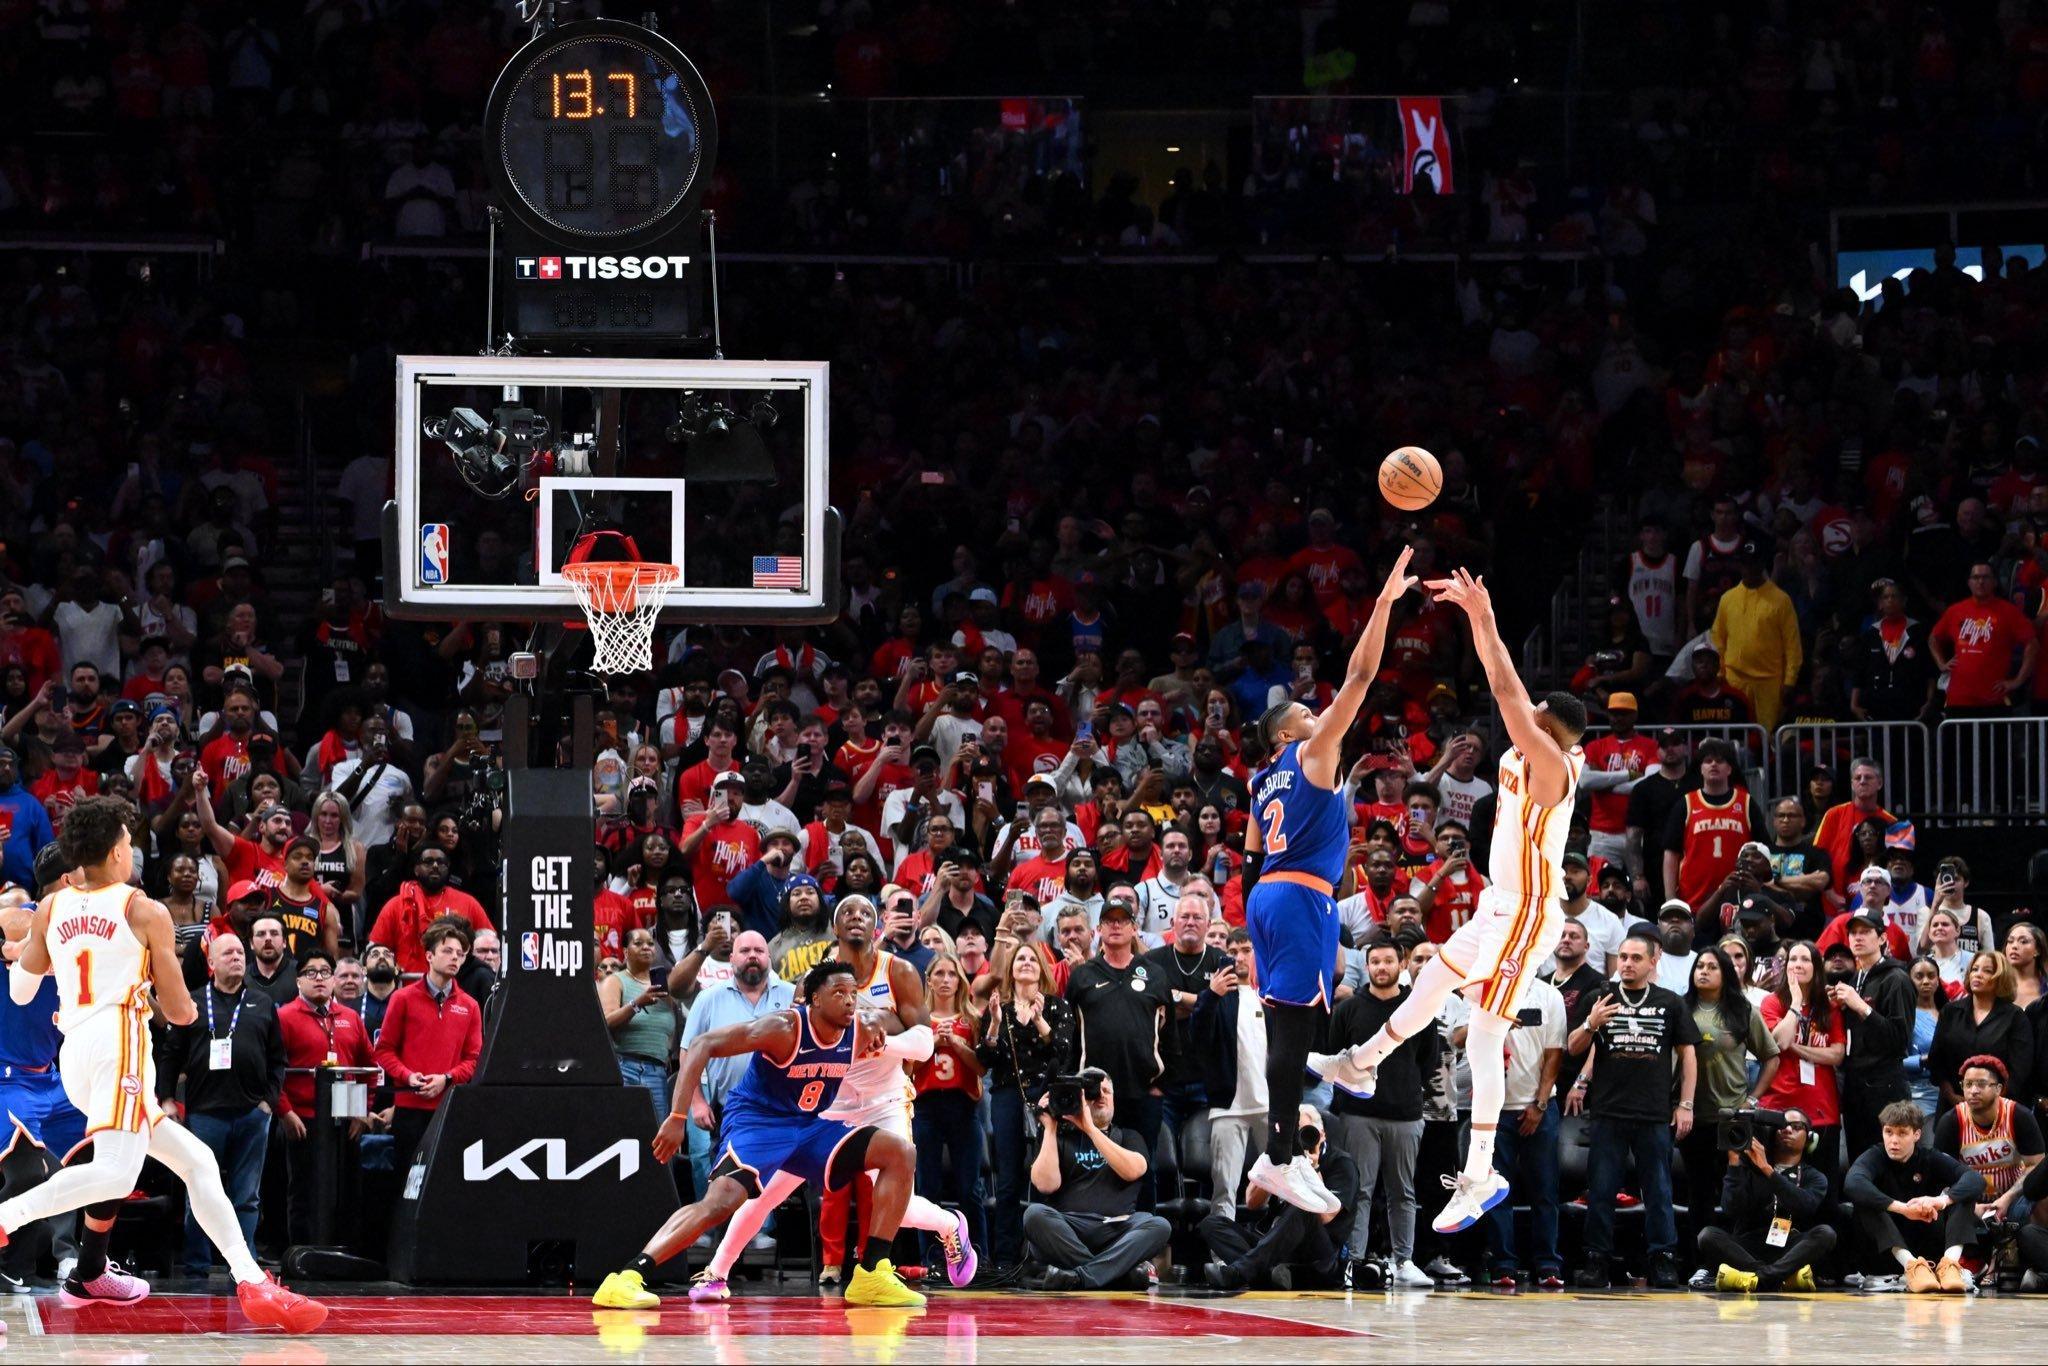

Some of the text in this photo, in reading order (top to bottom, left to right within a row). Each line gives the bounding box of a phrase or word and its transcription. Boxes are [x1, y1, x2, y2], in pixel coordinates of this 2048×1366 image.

[552, 69, 636, 119] 13.7
[565, 256, 691, 279] TISSOT
[1692, 707, 1731, 721] HAWKS
[1256, 770, 1295, 806] McBRIDE
[1442, 807, 1472, 821] PEDR
[1451, 801, 1472, 812] FOR
[1263, 798, 1288, 855] 2
[1693, 818, 1744, 835] ATLANTA
[1713, 835, 1722, 859] 1
[532, 857, 571, 891] GET
[534, 895, 572, 929] THE
[1158, 904, 1168, 919] 5
[58, 916, 119, 945] JOHNSON
[542, 933, 583, 976] App
[80, 949, 97, 1006] 1
[786, 1064, 818, 1079] NEW
[934, 1052, 955, 1081] 3
[797, 1080, 826, 1112] 8
[1960, 1143, 2012, 1166] awks
